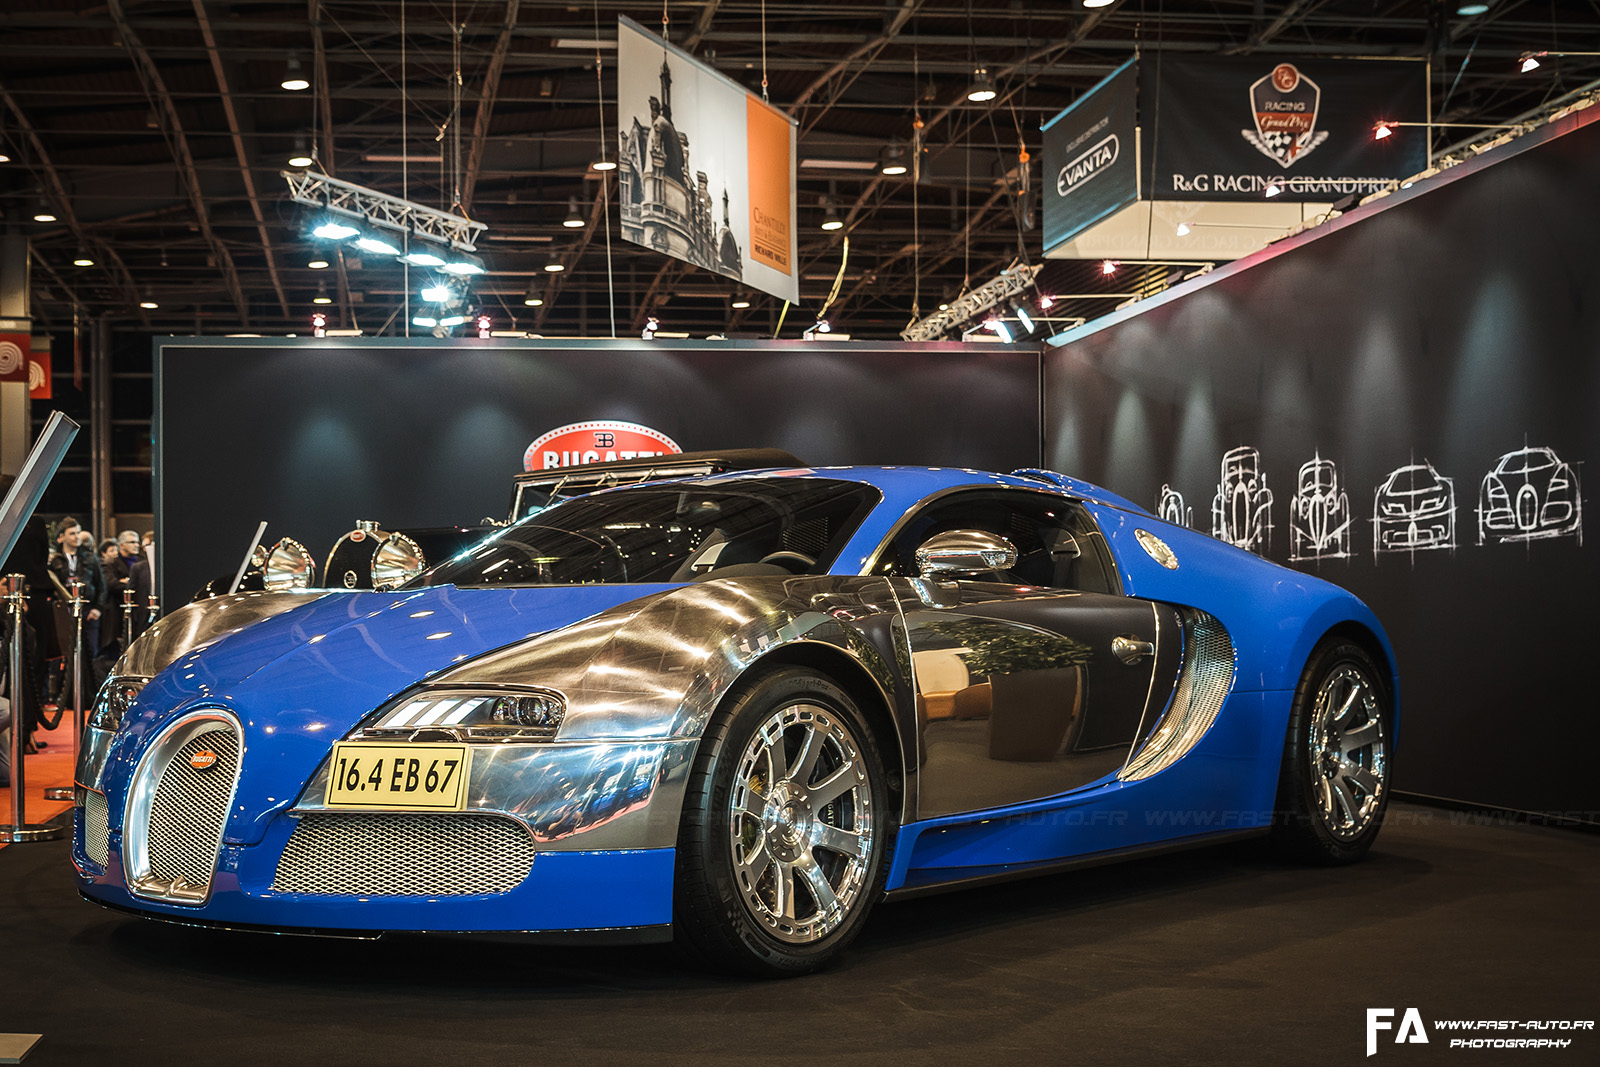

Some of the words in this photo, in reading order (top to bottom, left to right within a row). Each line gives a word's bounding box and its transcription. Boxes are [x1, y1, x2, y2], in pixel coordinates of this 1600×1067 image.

[1264, 101, 1306, 112] RACING
[1173, 173, 1209, 192] R&G
[1213, 174, 1286, 193] RACING
[1289, 175, 1398, 195] GRANDPRI
[337, 758, 384, 792] 16.4
[389, 758, 420, 792] EB
[424, 760, 459, 793] 67
